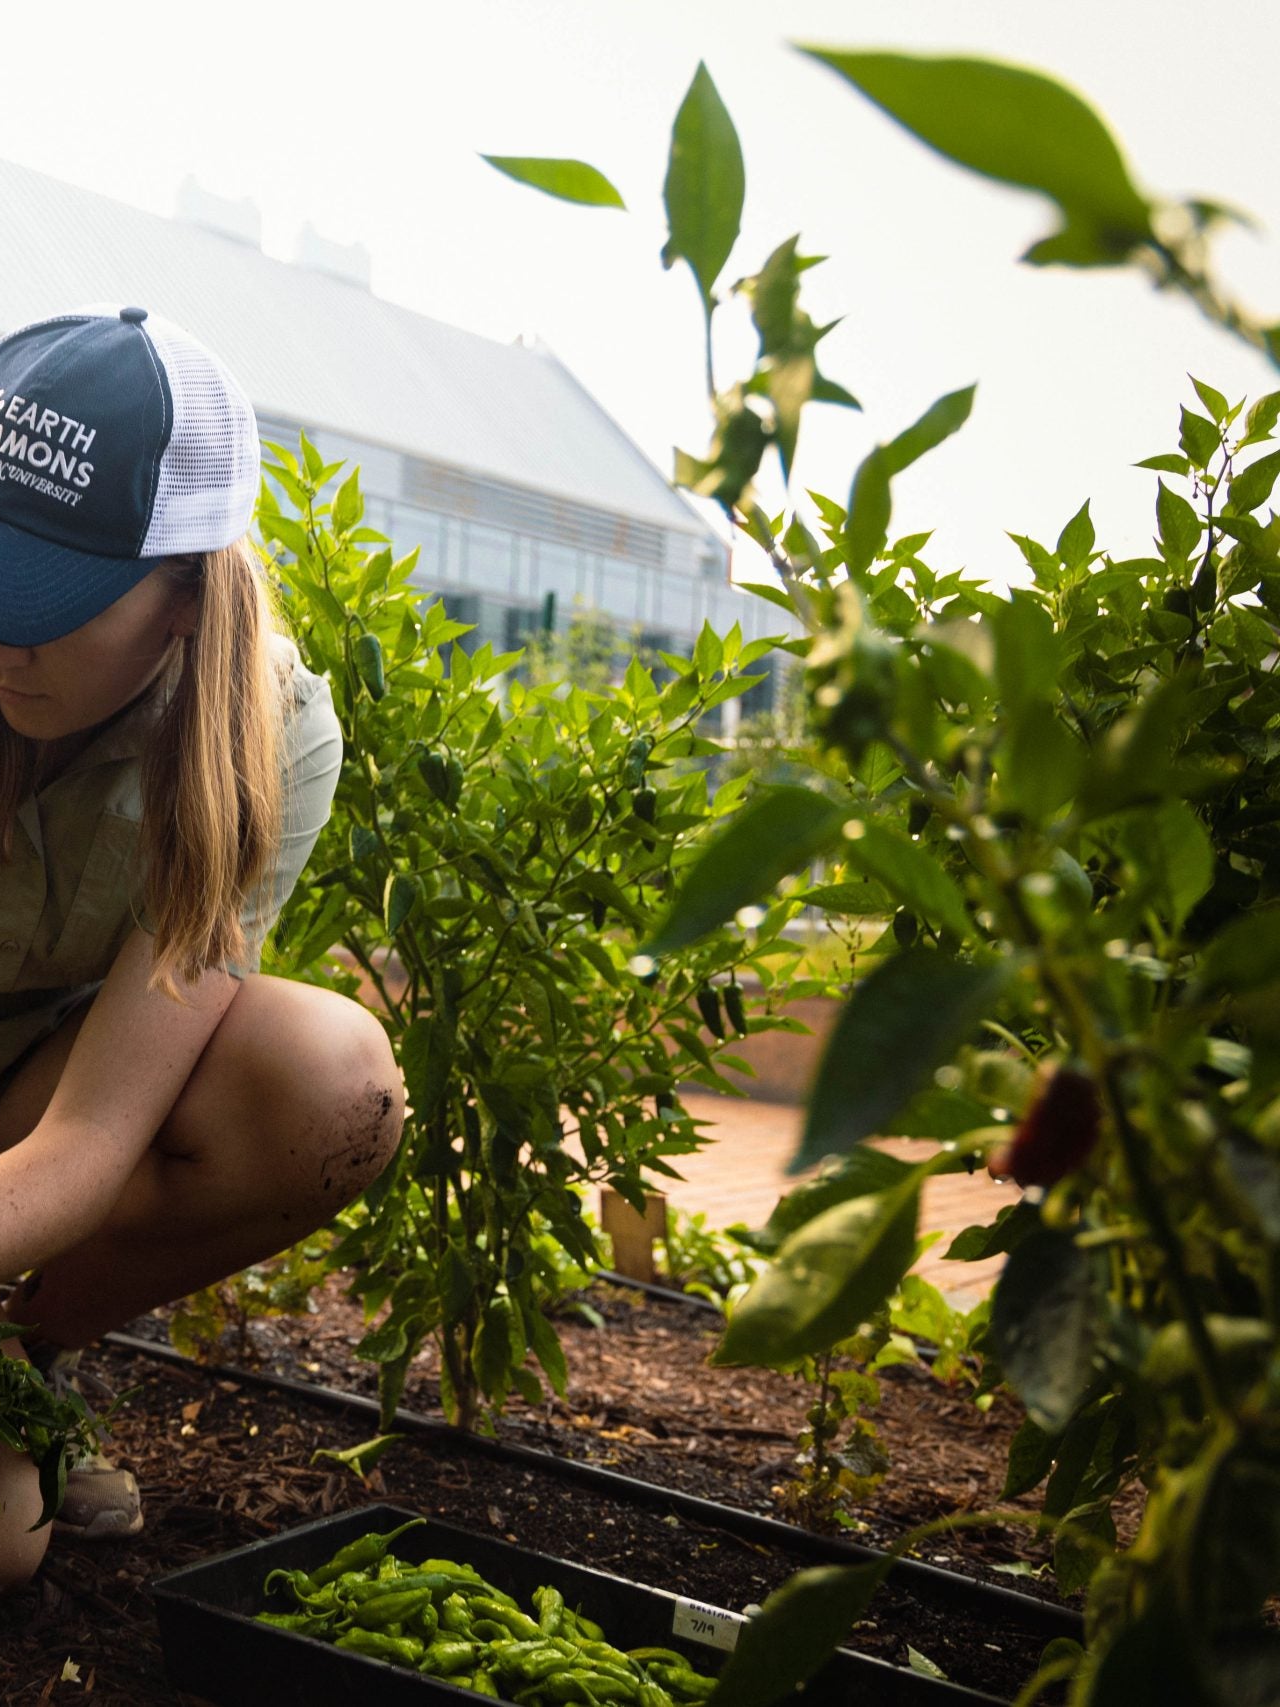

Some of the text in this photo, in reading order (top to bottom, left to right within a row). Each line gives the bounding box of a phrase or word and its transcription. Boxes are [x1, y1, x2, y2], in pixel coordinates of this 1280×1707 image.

[5, 395, 97, 454] EARTH
[8, 465, 84, 507] UNIVERSITY
[690, 1619, 716, 1637] 7/19
